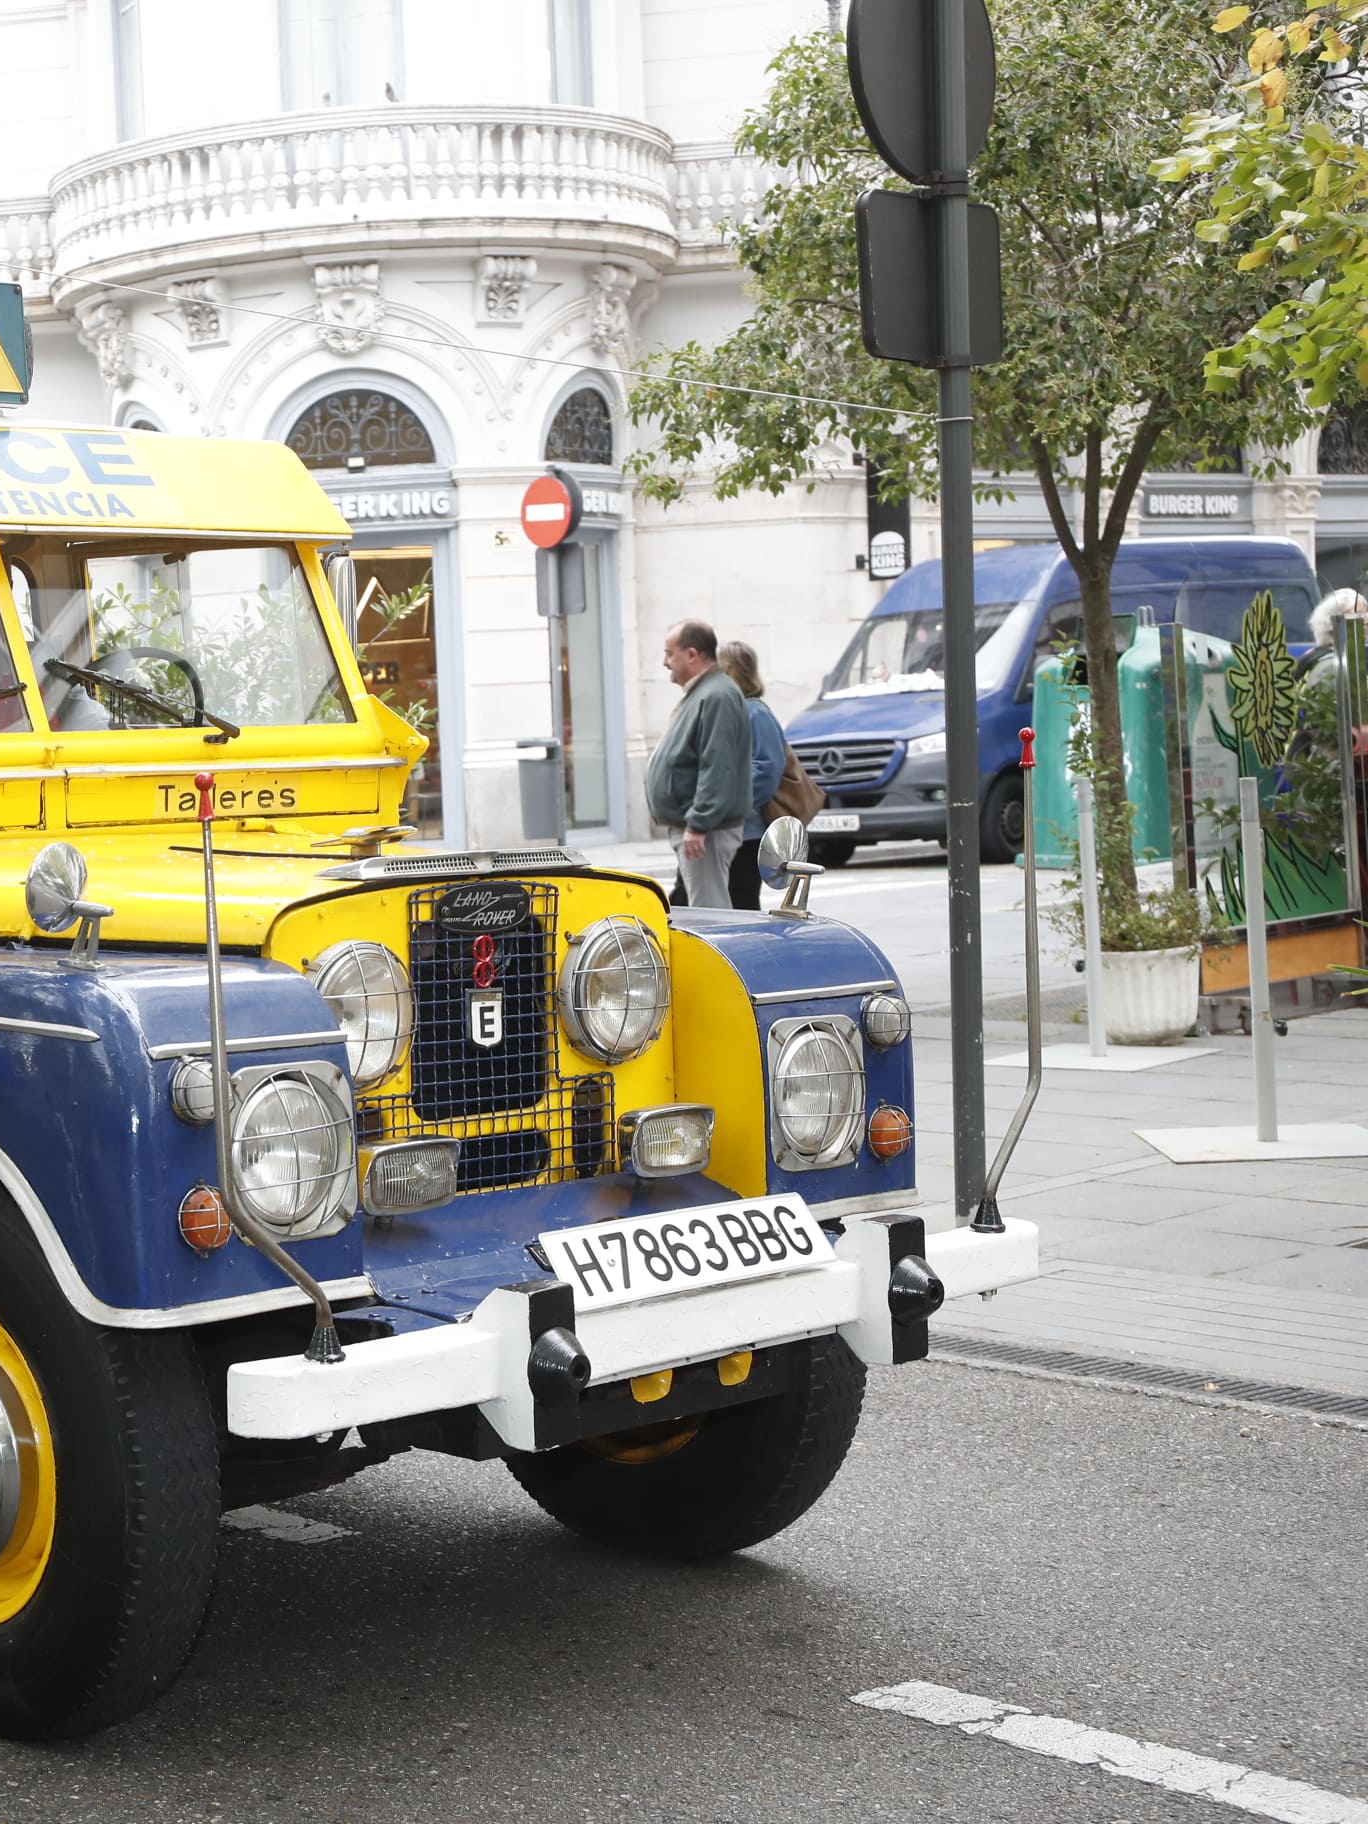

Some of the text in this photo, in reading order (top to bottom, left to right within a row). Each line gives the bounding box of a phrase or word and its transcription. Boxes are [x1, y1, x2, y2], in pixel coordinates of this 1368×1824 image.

[379, 491, 451, 517] KING
[1149, 494, 1239, 515] BURGER KING
[871, 543, 905, 555] BURGER
[871, 553, 905, 569] KING
[158, 783, 297, 813] Taleres
[453, 891, 492, 908] LAND
[473, 909, 516, 927] ROVER
[479, 1006, 495, 1039] E
